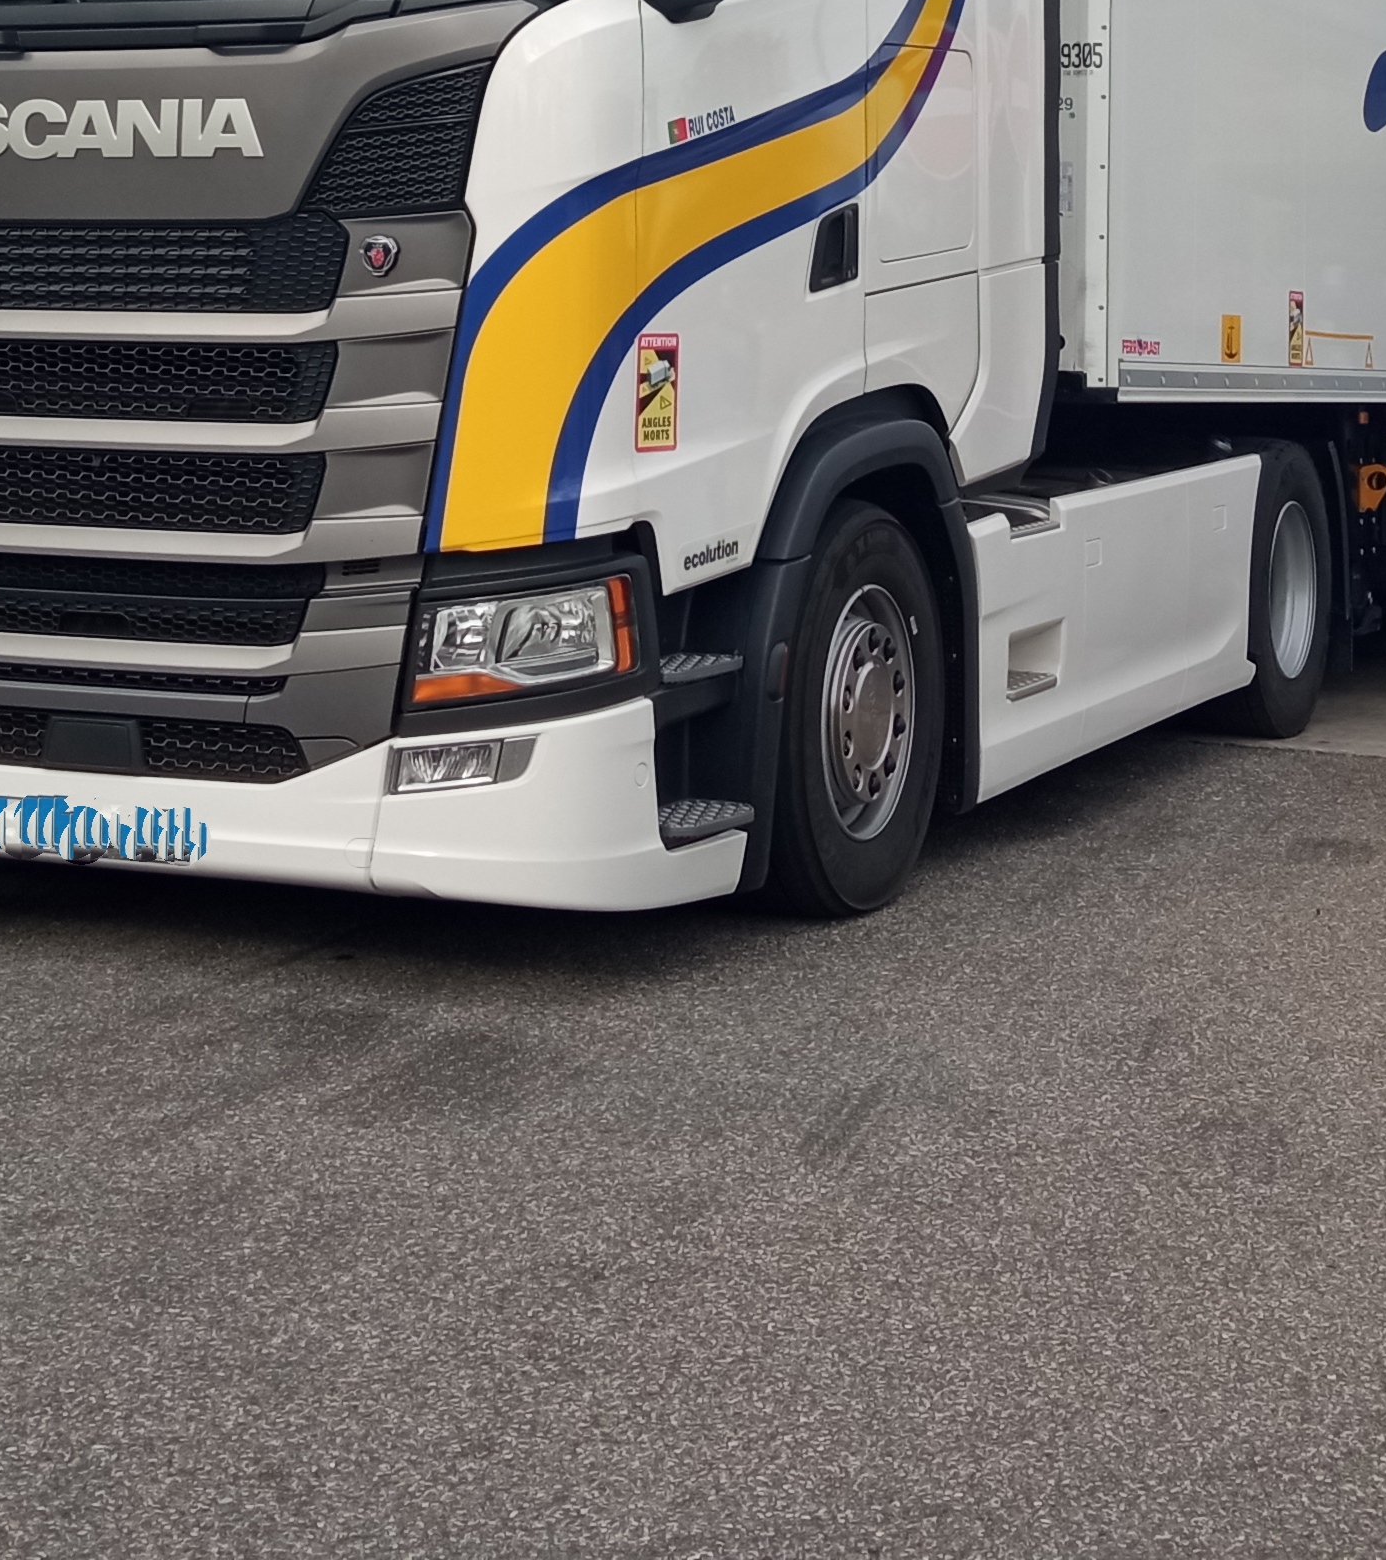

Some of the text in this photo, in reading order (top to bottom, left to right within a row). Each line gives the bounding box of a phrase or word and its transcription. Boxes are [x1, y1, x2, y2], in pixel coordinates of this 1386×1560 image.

[1060, 42, 1103, 69] 9305
[688, 105, 736, 138] RUI COSTA
[640, 336, 677, 348] ATTENTION
[641, 416, 672, 428] ANGLES
[643, 429, 670, 441] MORTS
[683, 539, 739, 571] ecolution
